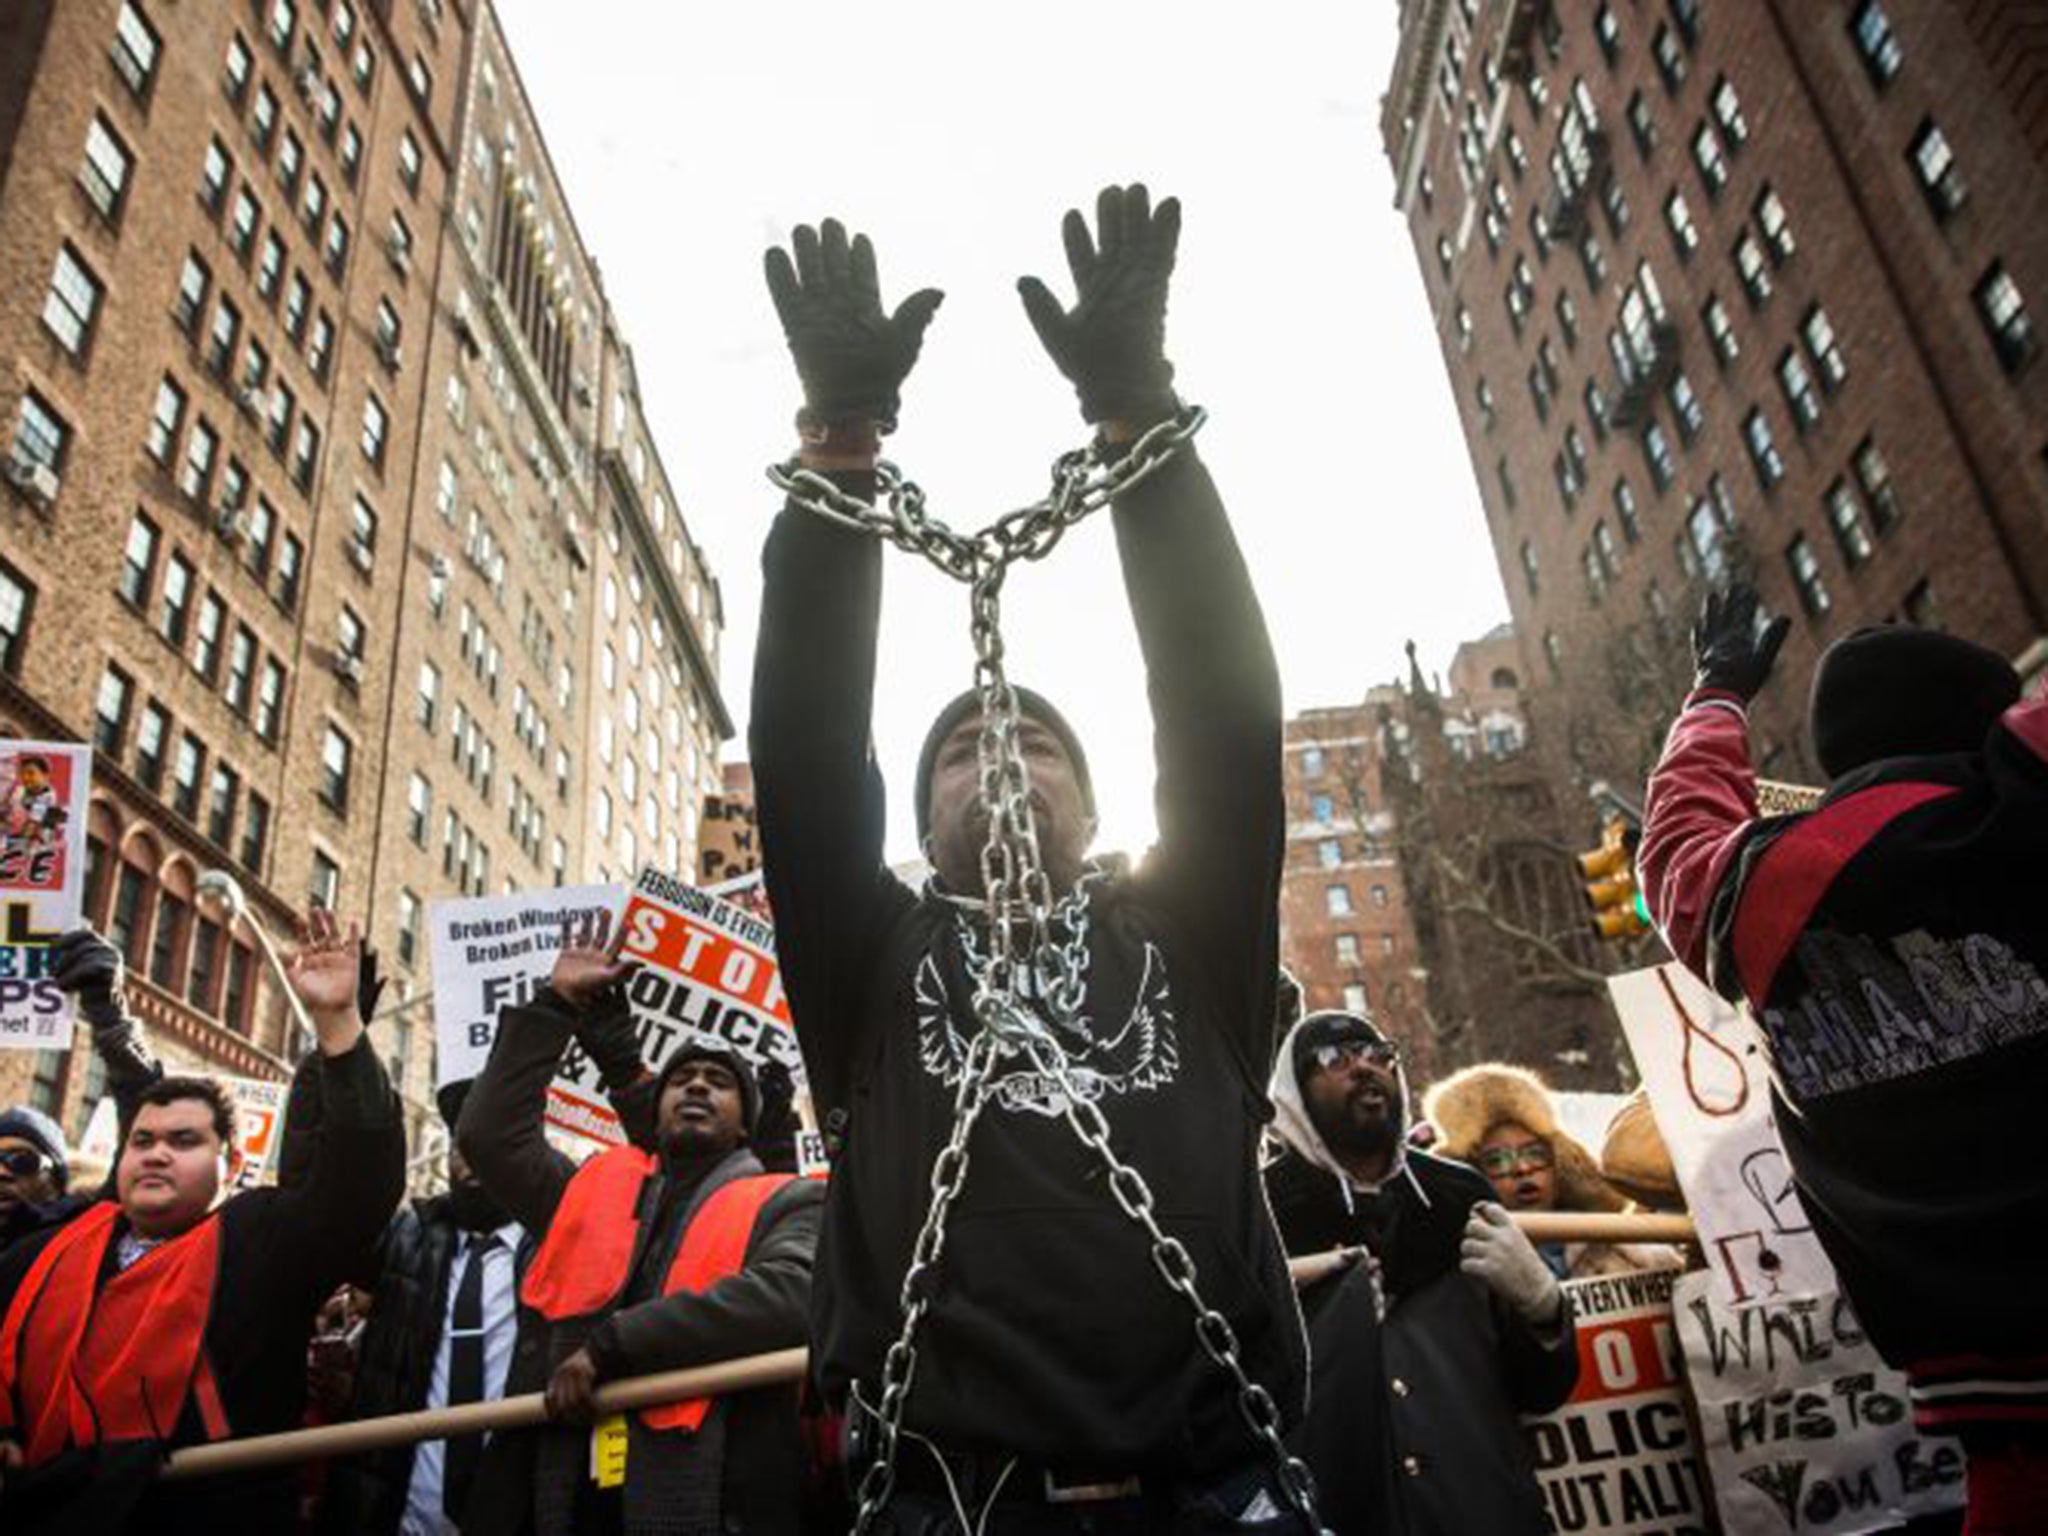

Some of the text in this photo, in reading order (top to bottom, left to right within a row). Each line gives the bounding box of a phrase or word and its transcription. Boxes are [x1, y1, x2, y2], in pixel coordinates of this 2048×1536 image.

[713, 900, 733, 927] IS
[449, 918, 517, 940] Broken
[466, 938, 533, 964] Broken
[630, 968, 788, 1058] OLICE
[468, 1022, 491, 1048] B
[803, 1135, 826, 1165] FE
